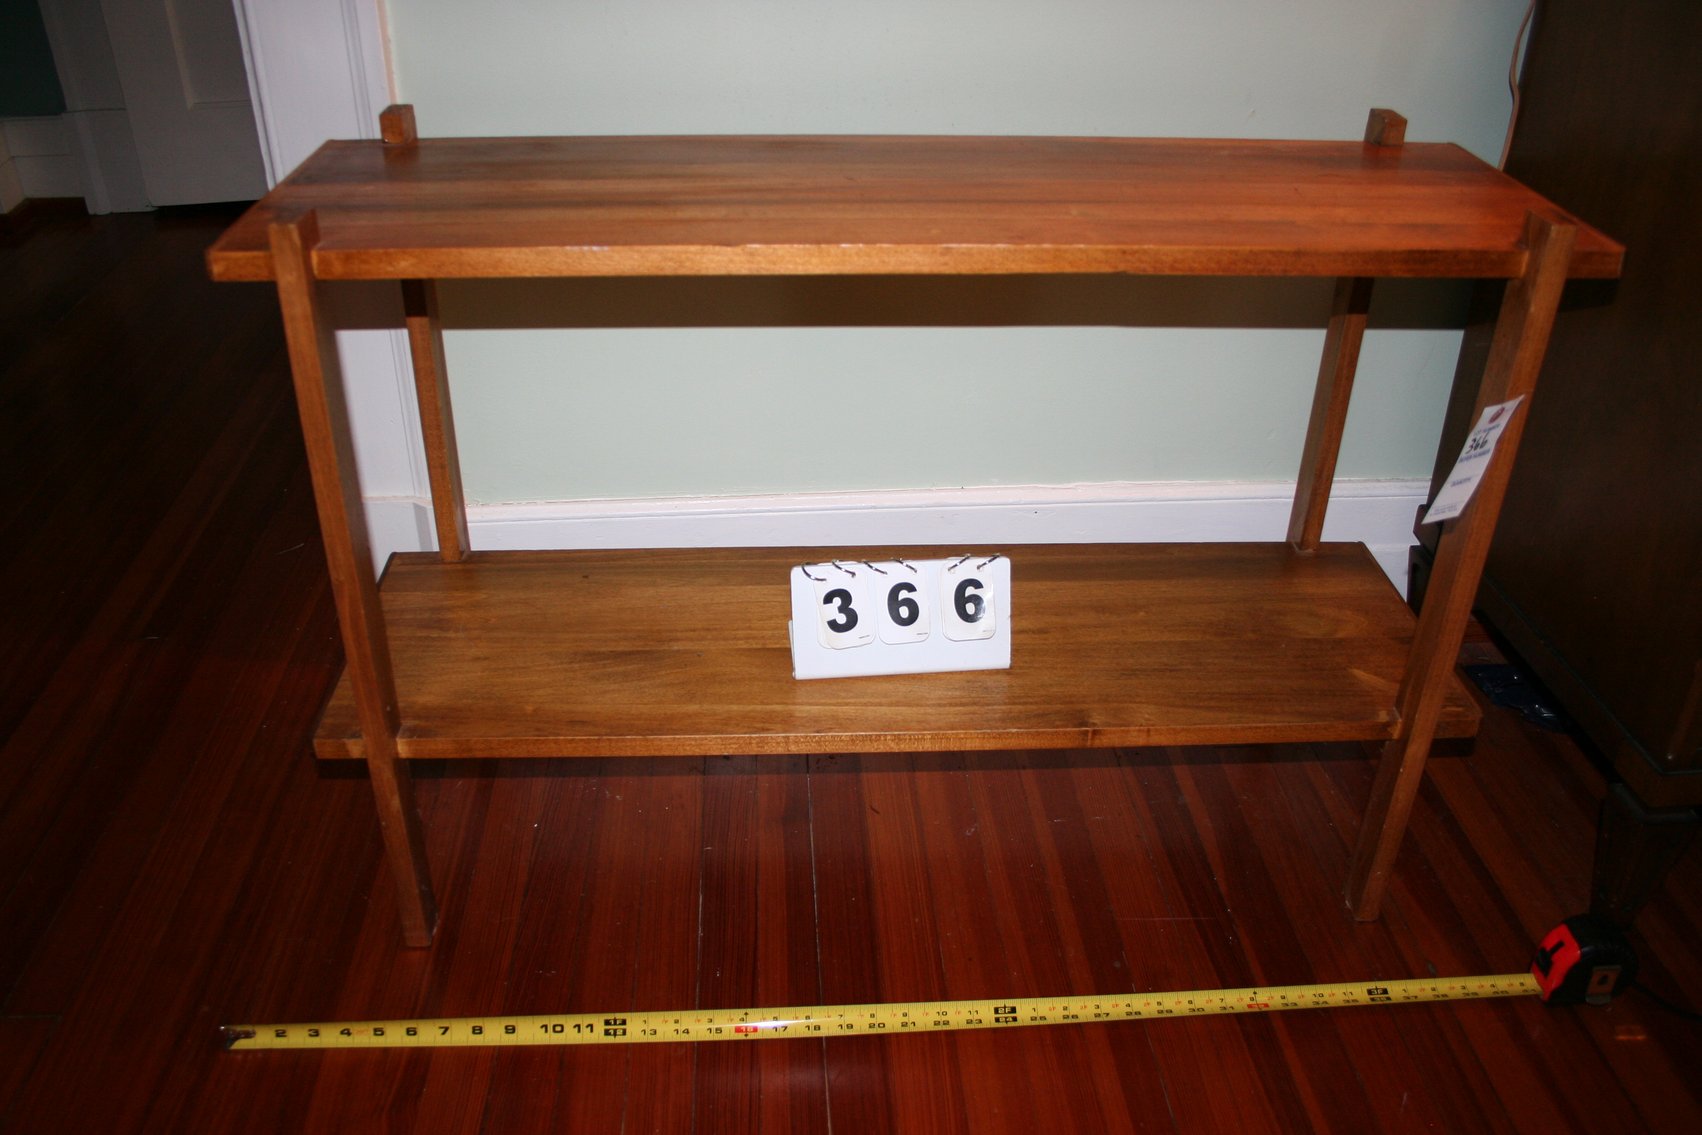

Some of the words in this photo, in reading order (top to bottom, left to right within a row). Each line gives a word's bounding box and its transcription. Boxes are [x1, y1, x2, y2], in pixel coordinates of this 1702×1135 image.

[275, 1029, 286, 1038] 2
[308, 1028, 320, 1037] 3
[340, 1028, 352, 1036] 4
[373, 1027, 384, 1036] 5
[406, 1027, 417, 1036] 6
[438, 1026, 449, 1035] 7
[472, 1025, 483, 1034] 8
[504, 1025, 516, 1034] 9
[540, 1024, 564, 1034] 10
[573, 1024, 594, 1033] 11
